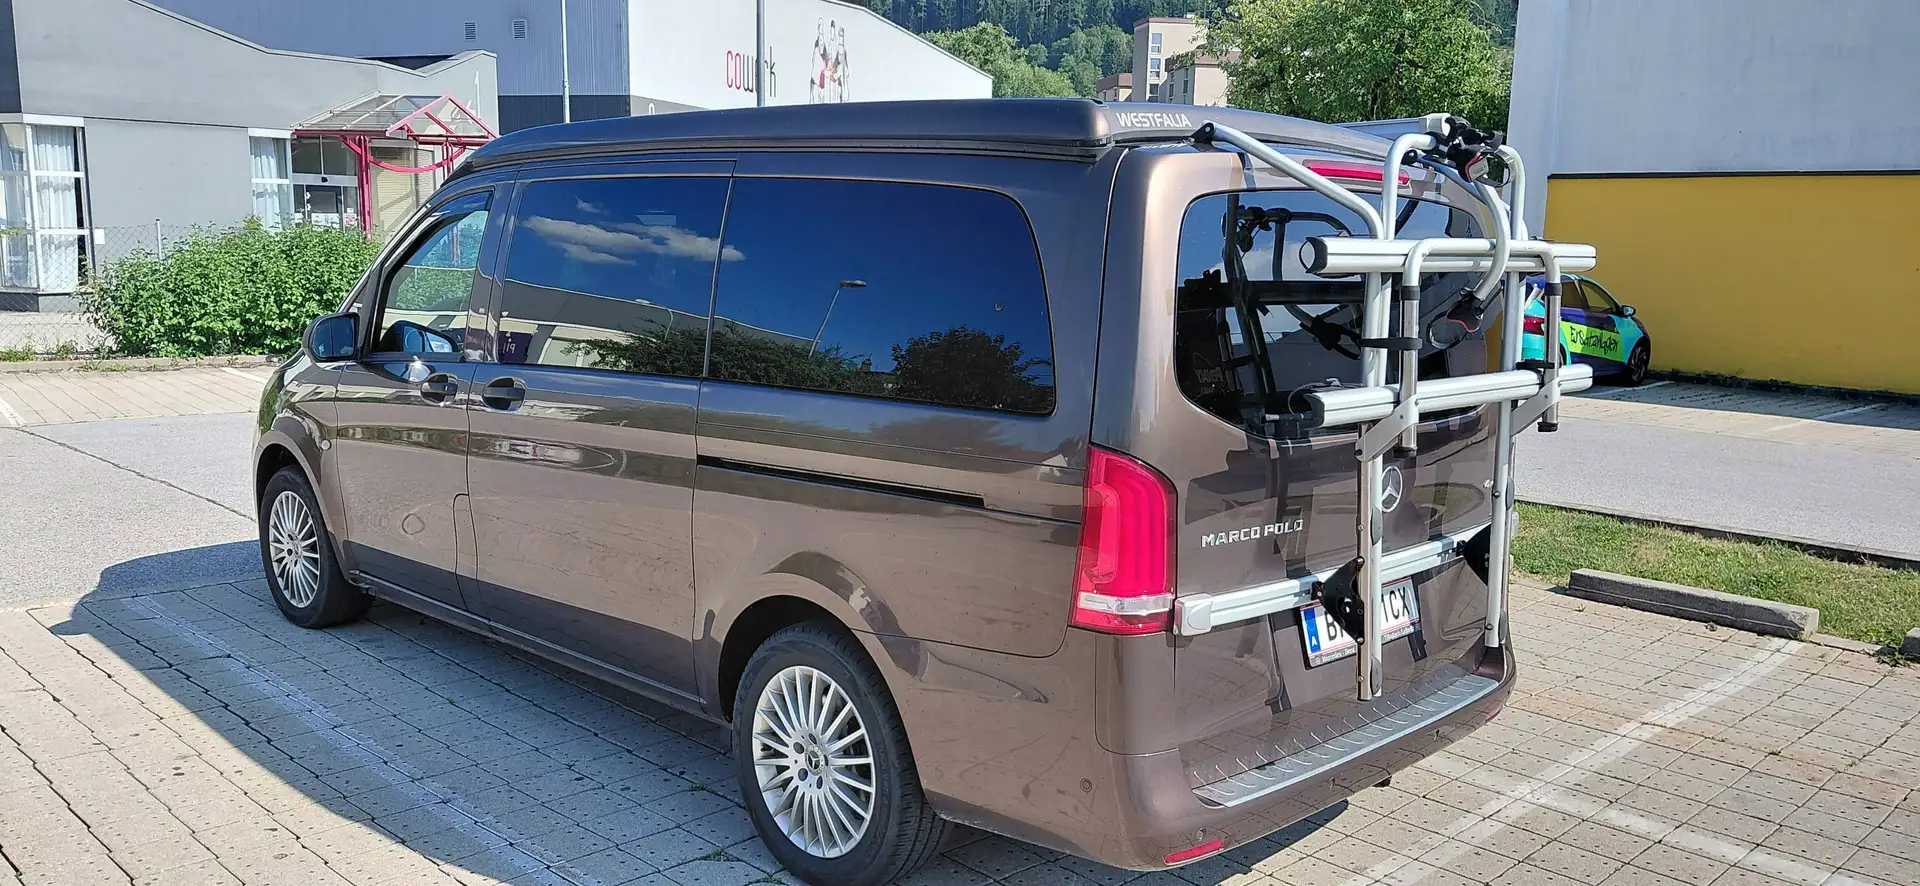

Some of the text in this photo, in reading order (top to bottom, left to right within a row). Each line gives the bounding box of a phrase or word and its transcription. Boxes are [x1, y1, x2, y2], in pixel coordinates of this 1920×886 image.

[726, 49, 776, 98] cowk
[1116, 112, 1193, 128] WESTFALIA
[1201, 519, 1304, 548] MARCO POLO
[1311, 636, 1318, 648] A
